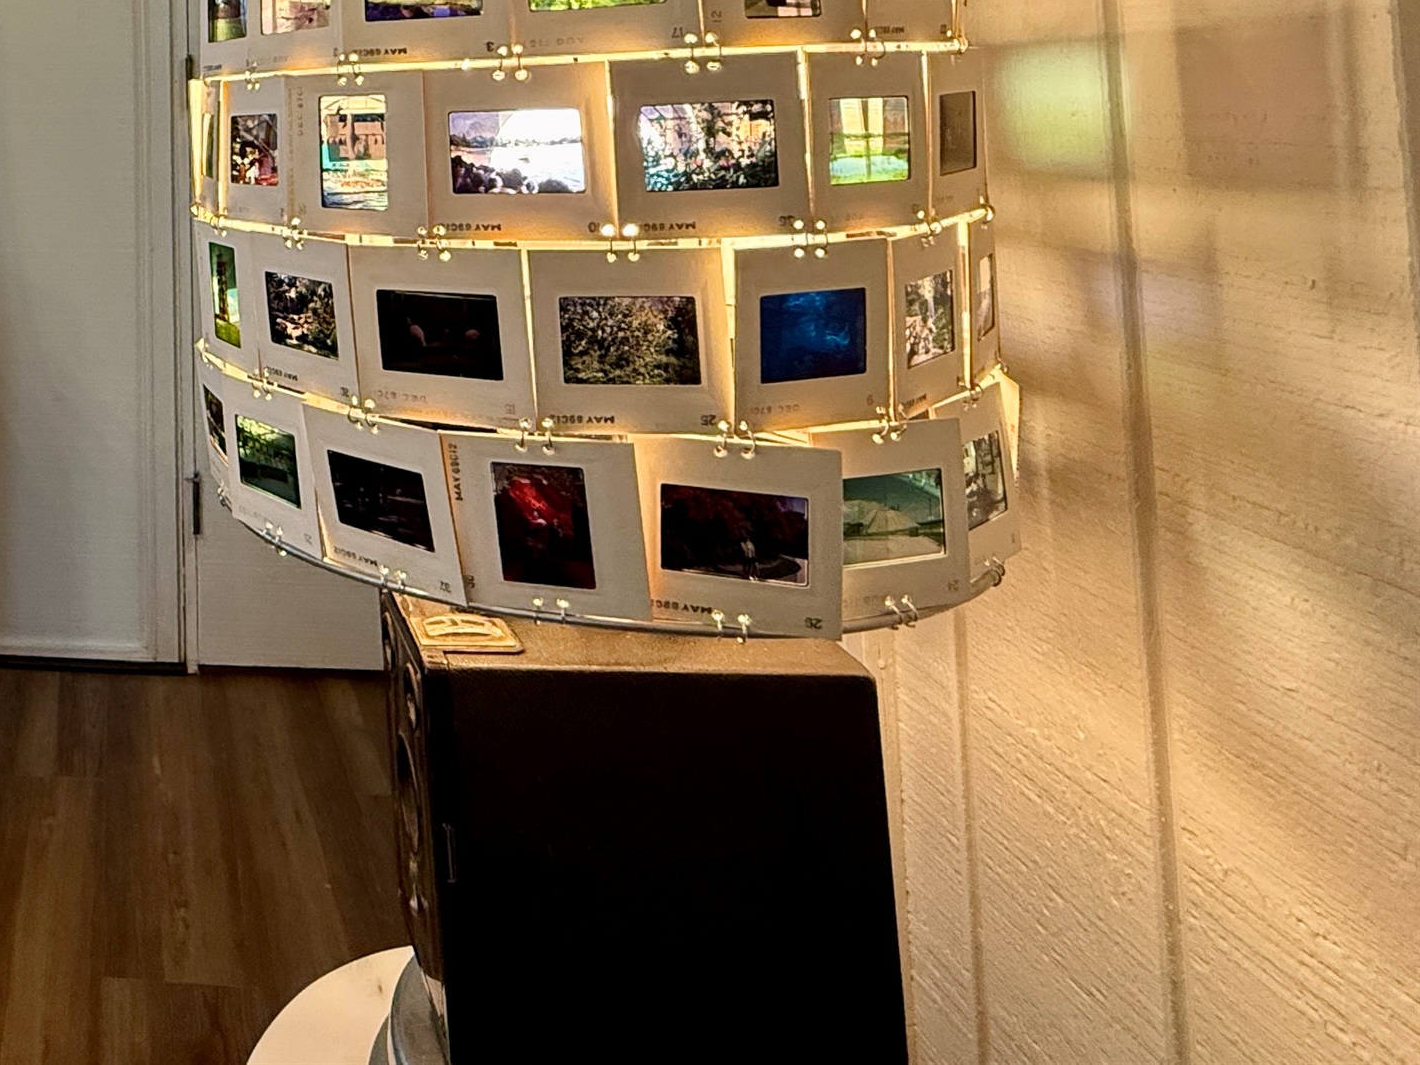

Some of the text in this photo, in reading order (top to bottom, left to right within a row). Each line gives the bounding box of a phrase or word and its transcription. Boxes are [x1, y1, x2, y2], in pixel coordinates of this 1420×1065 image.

[383, 47, 408, 55] MAY
[473, 223, 502, 231] MAY
[667, 221, 697, 232] MAY
[586, 415, 615, 425] MAY
[700, 414, 717, 426] 25
[452, 475, 464, 502] MAY
[358, 555, 378, 567] MAY
[681, 603, 714, 615] MAY
